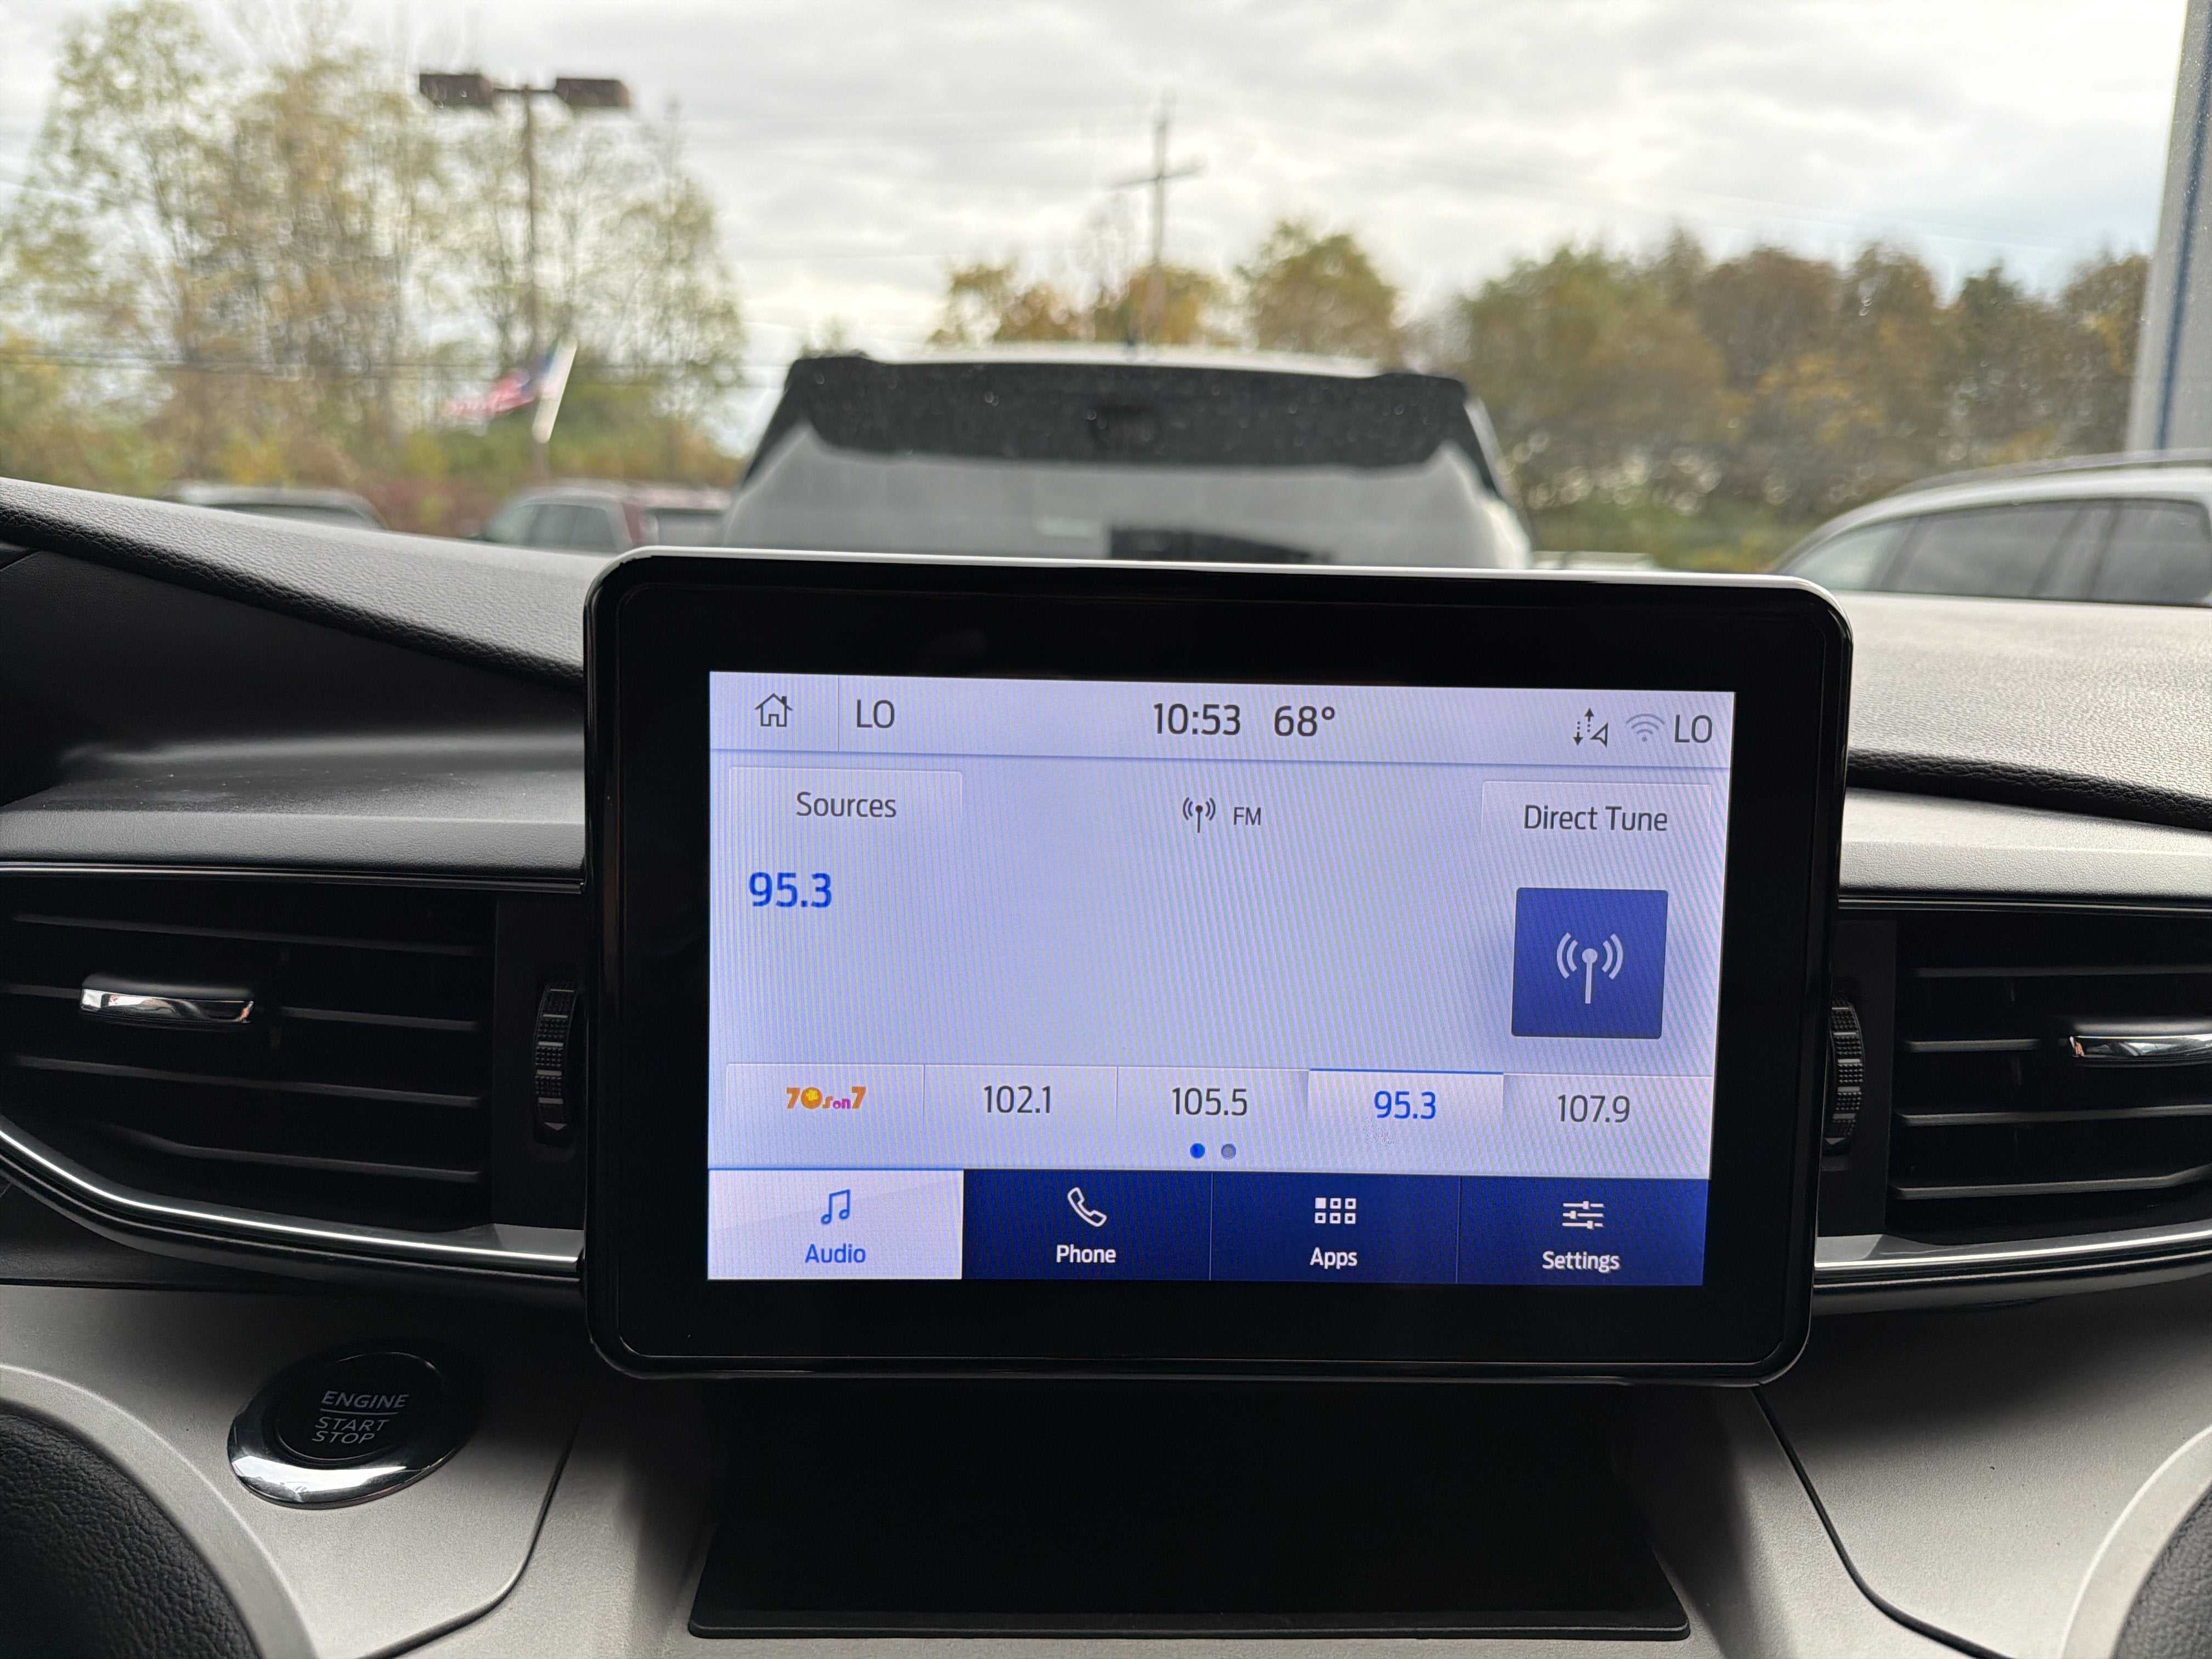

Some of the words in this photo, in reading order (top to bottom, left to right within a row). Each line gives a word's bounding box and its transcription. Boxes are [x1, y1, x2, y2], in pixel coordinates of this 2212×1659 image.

[856, 699, 895, 729] LO
[1154, 703, 1240, 735] 10:53
[1274, 706, 1335, 737] 68°
[1674, 714, 1712, 743] LO
[796, 792, 897, 818] Sources
[1233, 807, 1261, 826] FM
[1524, 804, 1598, 830] Direct
[1605, 806, 1667, 831] Tune
[749, 872, 832, 908] 95.3
[984, 1085, 1051, 1114] 102.1
[1172, 1087, 1248, 1116] 105.5
[1374, 1091, 1436, 1120] 95.3
[1557, 1094, 1630, 1123] 107.9
[805, 1244, 866, 1263] Audio
[1056, 1244, 1116, 1263] Phone
[1310, 1248, 1357, 1270] Apps
[1542, 1250, 1620, 1273] Settings
[321, 1390, 410, 1409] ENGINE
[315, 1417, 390, 1431] START
[312, 1431, 375, 1444] STOP
